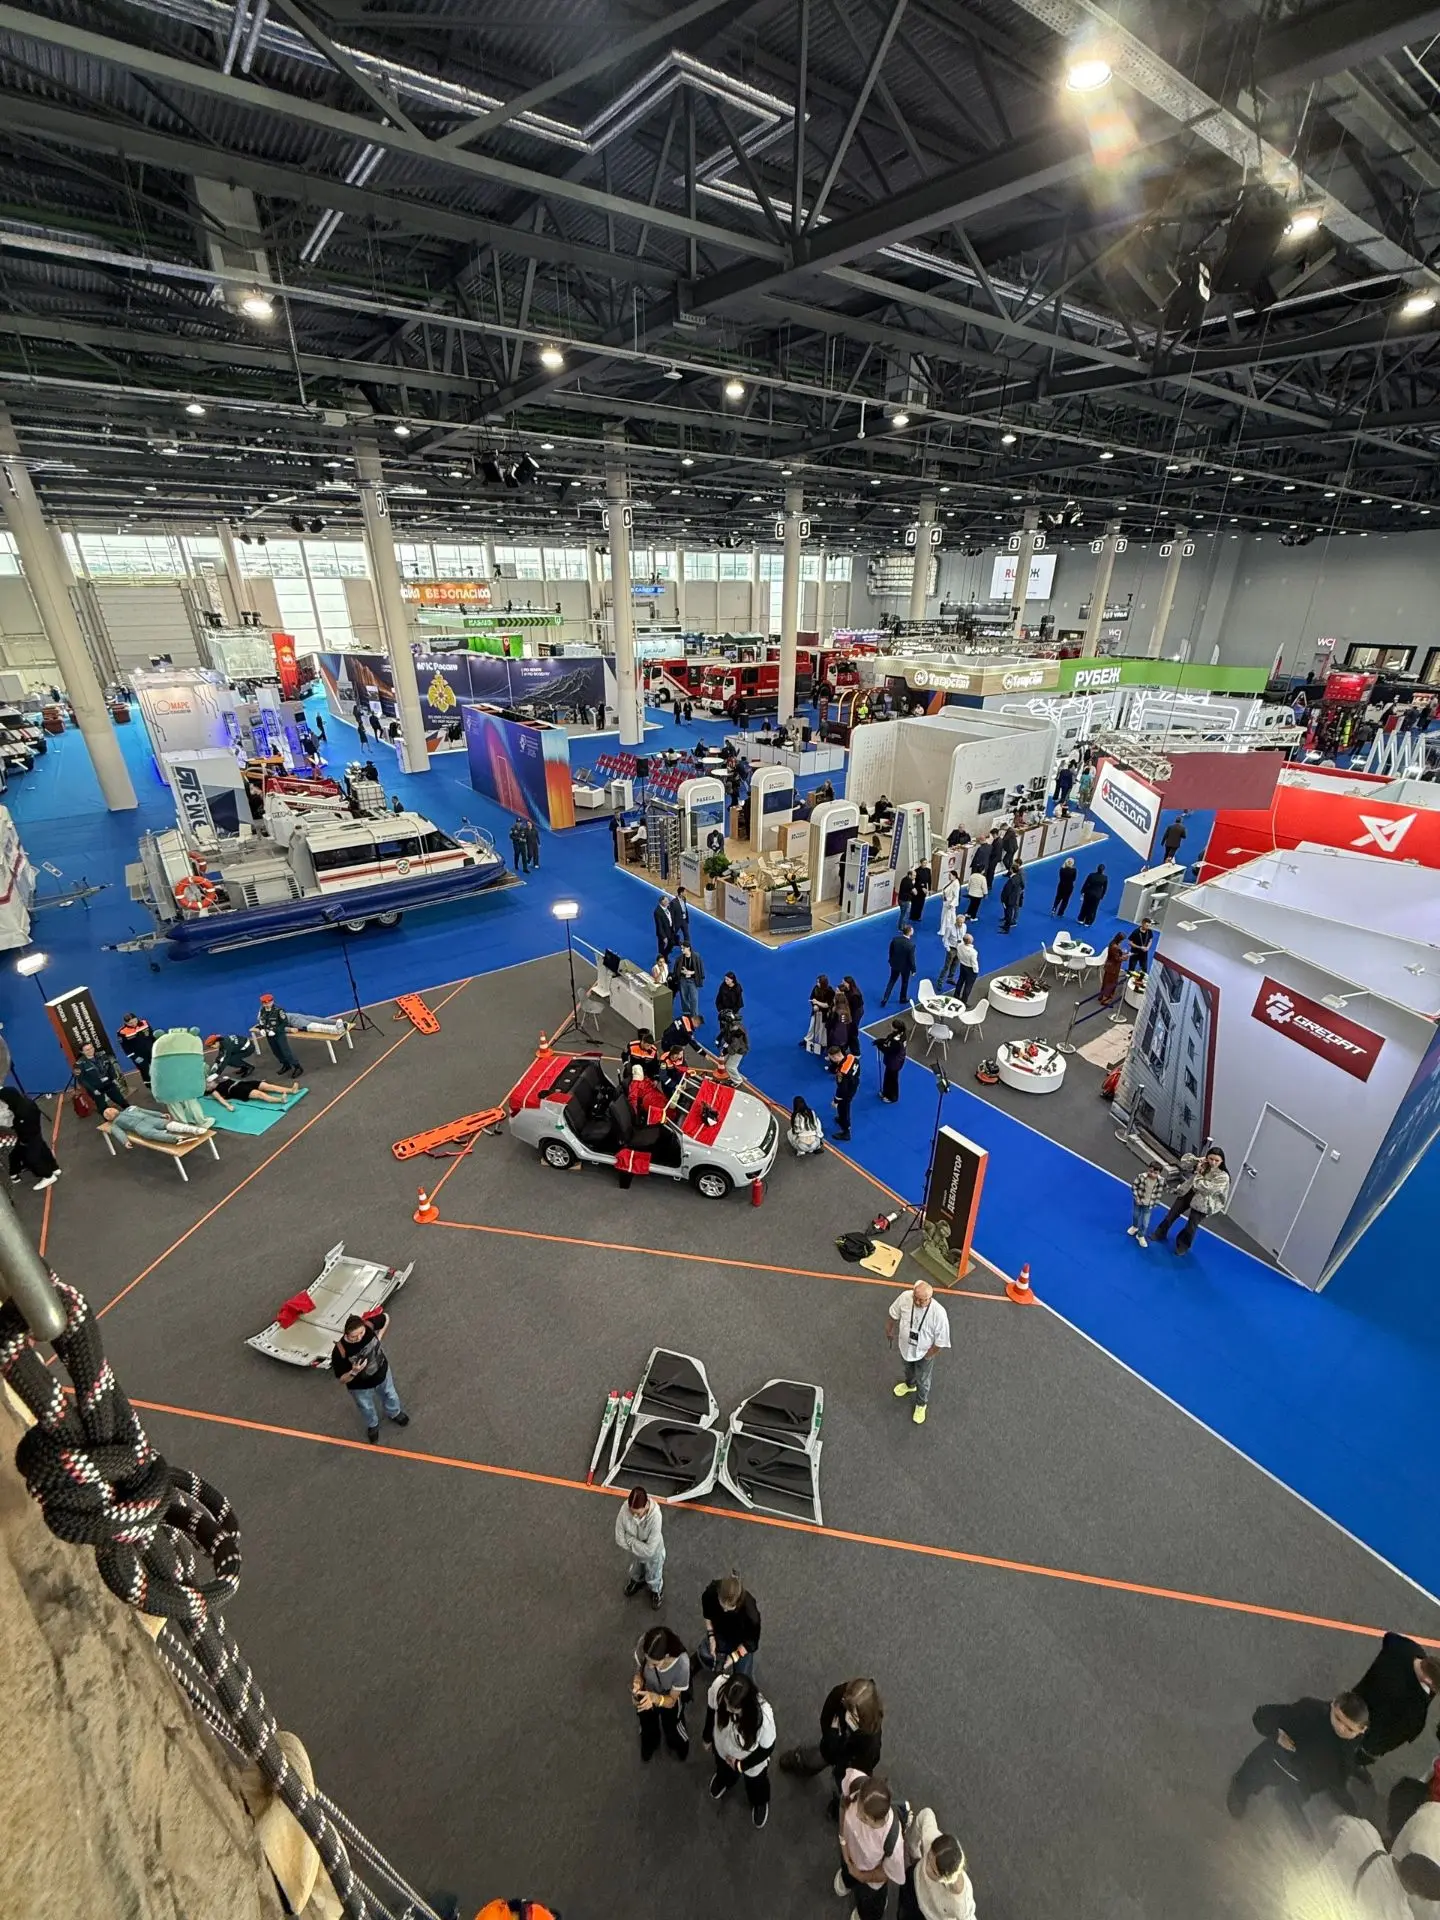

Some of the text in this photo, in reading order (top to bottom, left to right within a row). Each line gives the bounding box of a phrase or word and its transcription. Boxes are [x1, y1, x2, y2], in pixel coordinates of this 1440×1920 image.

[779, 525, 783, 536] 5
[802, 523, 807, 534] 5
[908, 532, 914, 542] 4
[932, 531, 938, 541] 4
[1011, 539, 1017, 548] 3
[1035, 538, 1042, 547] 3
[1094, 542, 1101, 551] 2
[1118, 541, 1124, 550] 2
[1317, 638, 1333, 647] WC
[1074, 667, 1122, 688] РУБЕЖ
[946, 1154, 963, 1214] ДЕБЛОКАТОР
